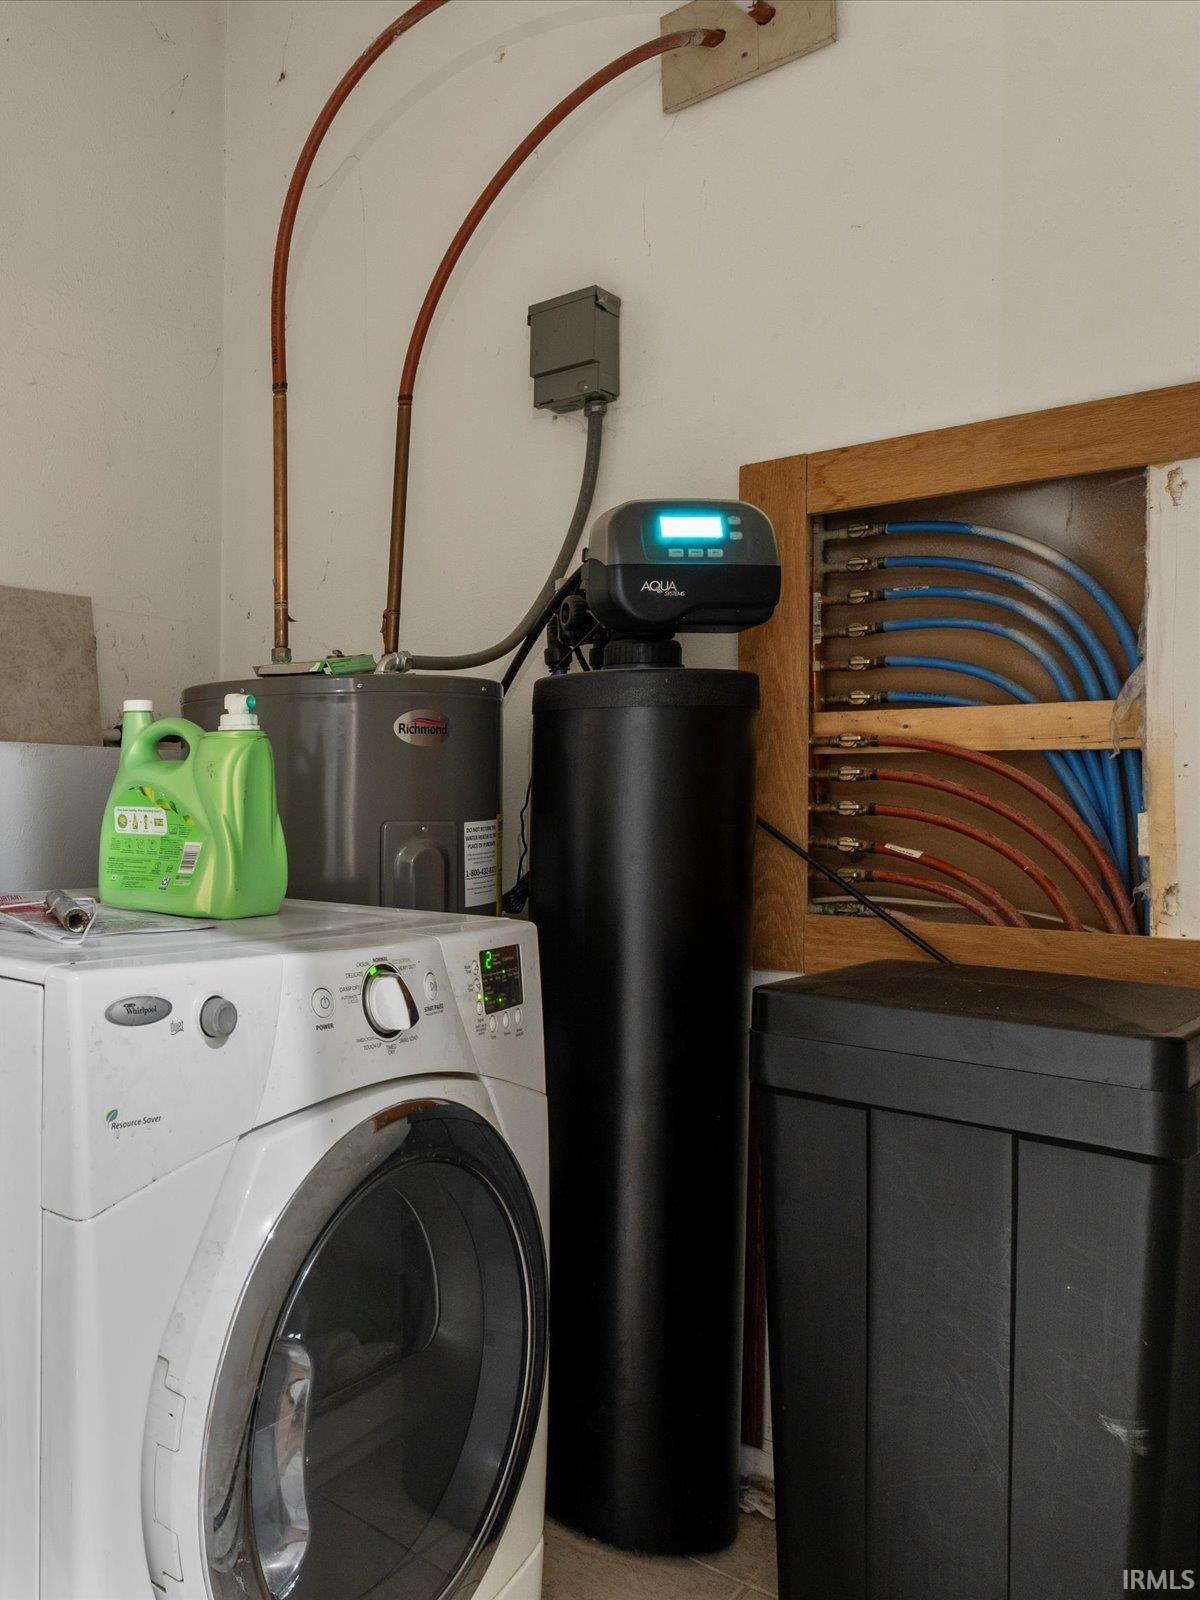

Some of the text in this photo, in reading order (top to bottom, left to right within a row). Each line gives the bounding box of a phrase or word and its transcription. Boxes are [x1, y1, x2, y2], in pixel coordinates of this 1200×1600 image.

[640, 580, 677, 593] AQUA
[398, 722, 448, 735] Richmond
[125, 1004, 158, 1016] Whirlpool
[316, 1022, 335, 1031] POWER
[111, 1115, 162, 1130] Resource Saver
